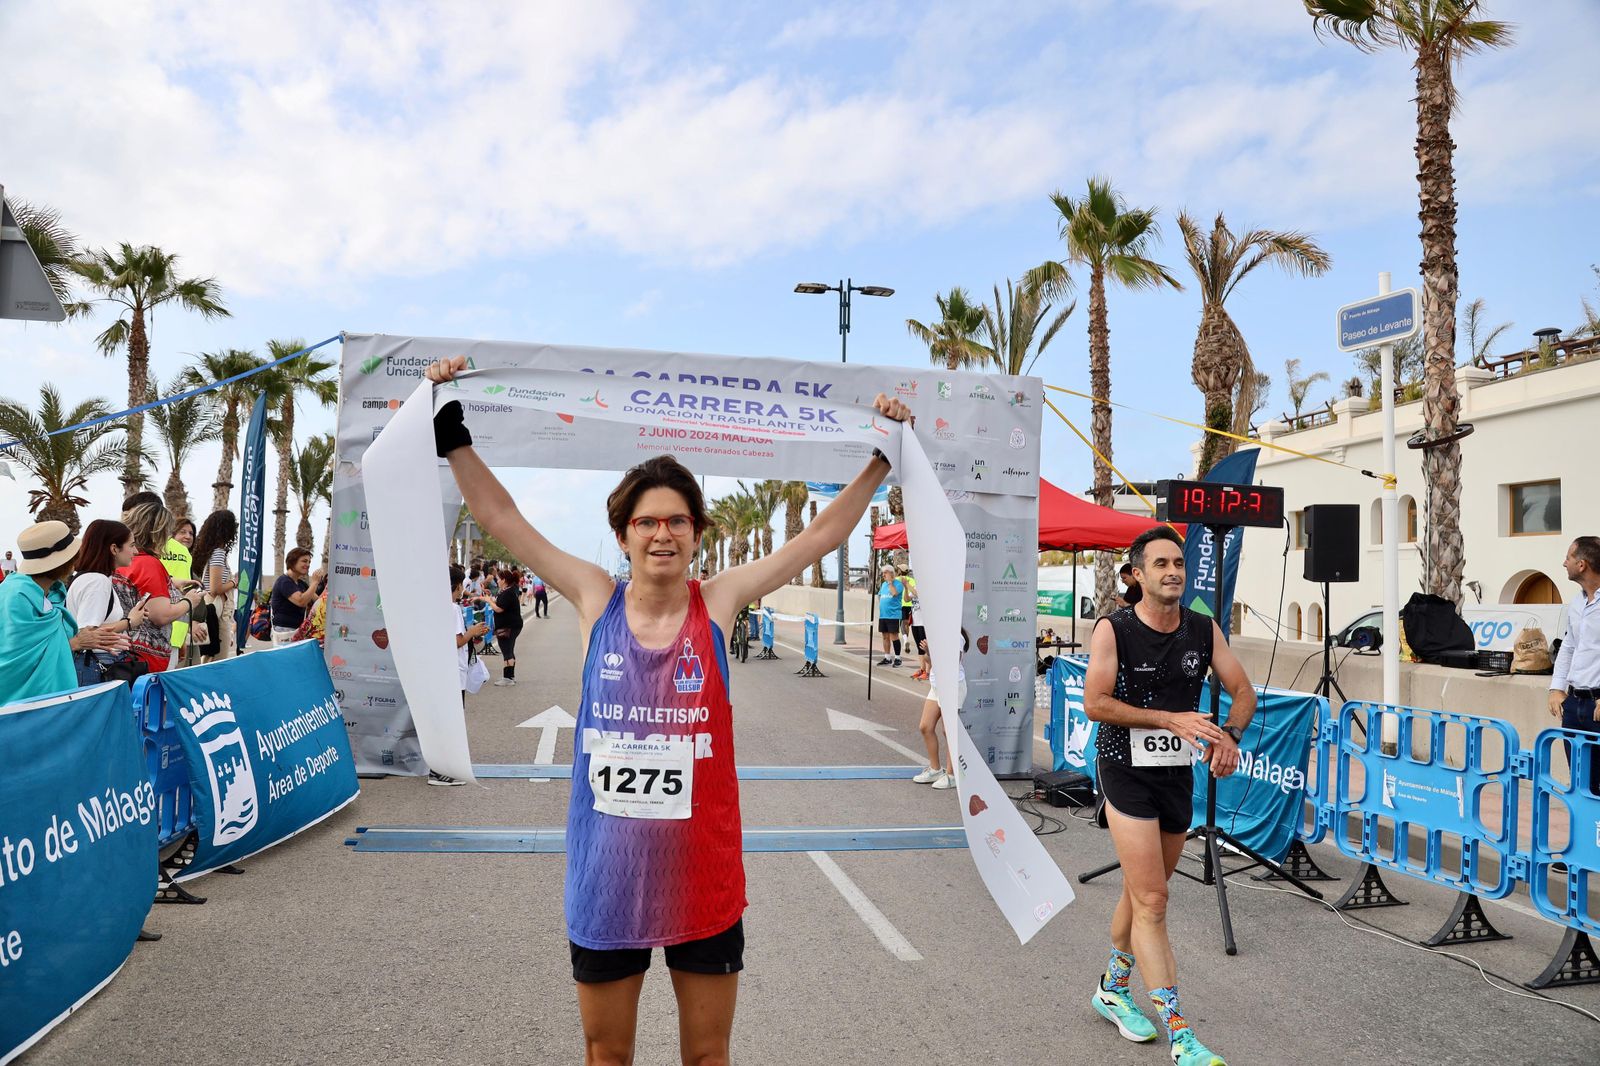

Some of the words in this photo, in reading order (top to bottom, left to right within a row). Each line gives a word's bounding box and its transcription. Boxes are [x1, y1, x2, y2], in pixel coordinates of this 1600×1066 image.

[1342, 329, 1367, 341] Paseo
[1368, 325, 1378, 335] de
[1380, 317, 1412, 332] Levante
[386, 356, 441, 367] Fundació
[507, 392, 548, 401] Unicaja
[509, 386, 566, 399] Fundación
[795, 381, 833, 399] 5K
[969, 393, 995, 401] ATHEMA
[468, 403, 513, 414] hospitales
[630, 389, 789, 419] CARRERA
[798, 407, 840, 425] 5K
[708, 413, 806, 431] TRASPLANTE
[810, 424, 845, 433] VIDA
[639, 427, 646, 437] 2
[648, 427, 687, 439] JUNIO
[690, 430, 719, 441] 2024
[637, 443, 671, 452] Memorial
[672, 444, 703, 454] Vicente
[704, 446, 741, 456] Granados
[742, 448, 775, 458] Cabezas
[975, 472, 982, 480] A
[1470, 621, 1513, 647] rgo
[678, 684, 700, 692] DELSUR
[1007, 691, 1020, 699] un
[592, 701, 624, 720] CLUB
[628, 705, 709, 724] ATLETISMO
[1009, 706, 1016, 715] A
[256, 704, 329, 763] Ayuntamiento
[324, 697, 338, 720] de
[622, 743, 658, 751] CARRERA
[1143, 735, 1182, 752] 630
[269, 772, 294, 804] Área
[294, 763, 308, 787] de
[305, 745, 339, 778] Deporte
[1237, 748, 1305, 794] Málaga
[598, 765, 683, 795] 1275
[45, 814, 78, 863] de
[78, 780, 156, 843] Málaga
